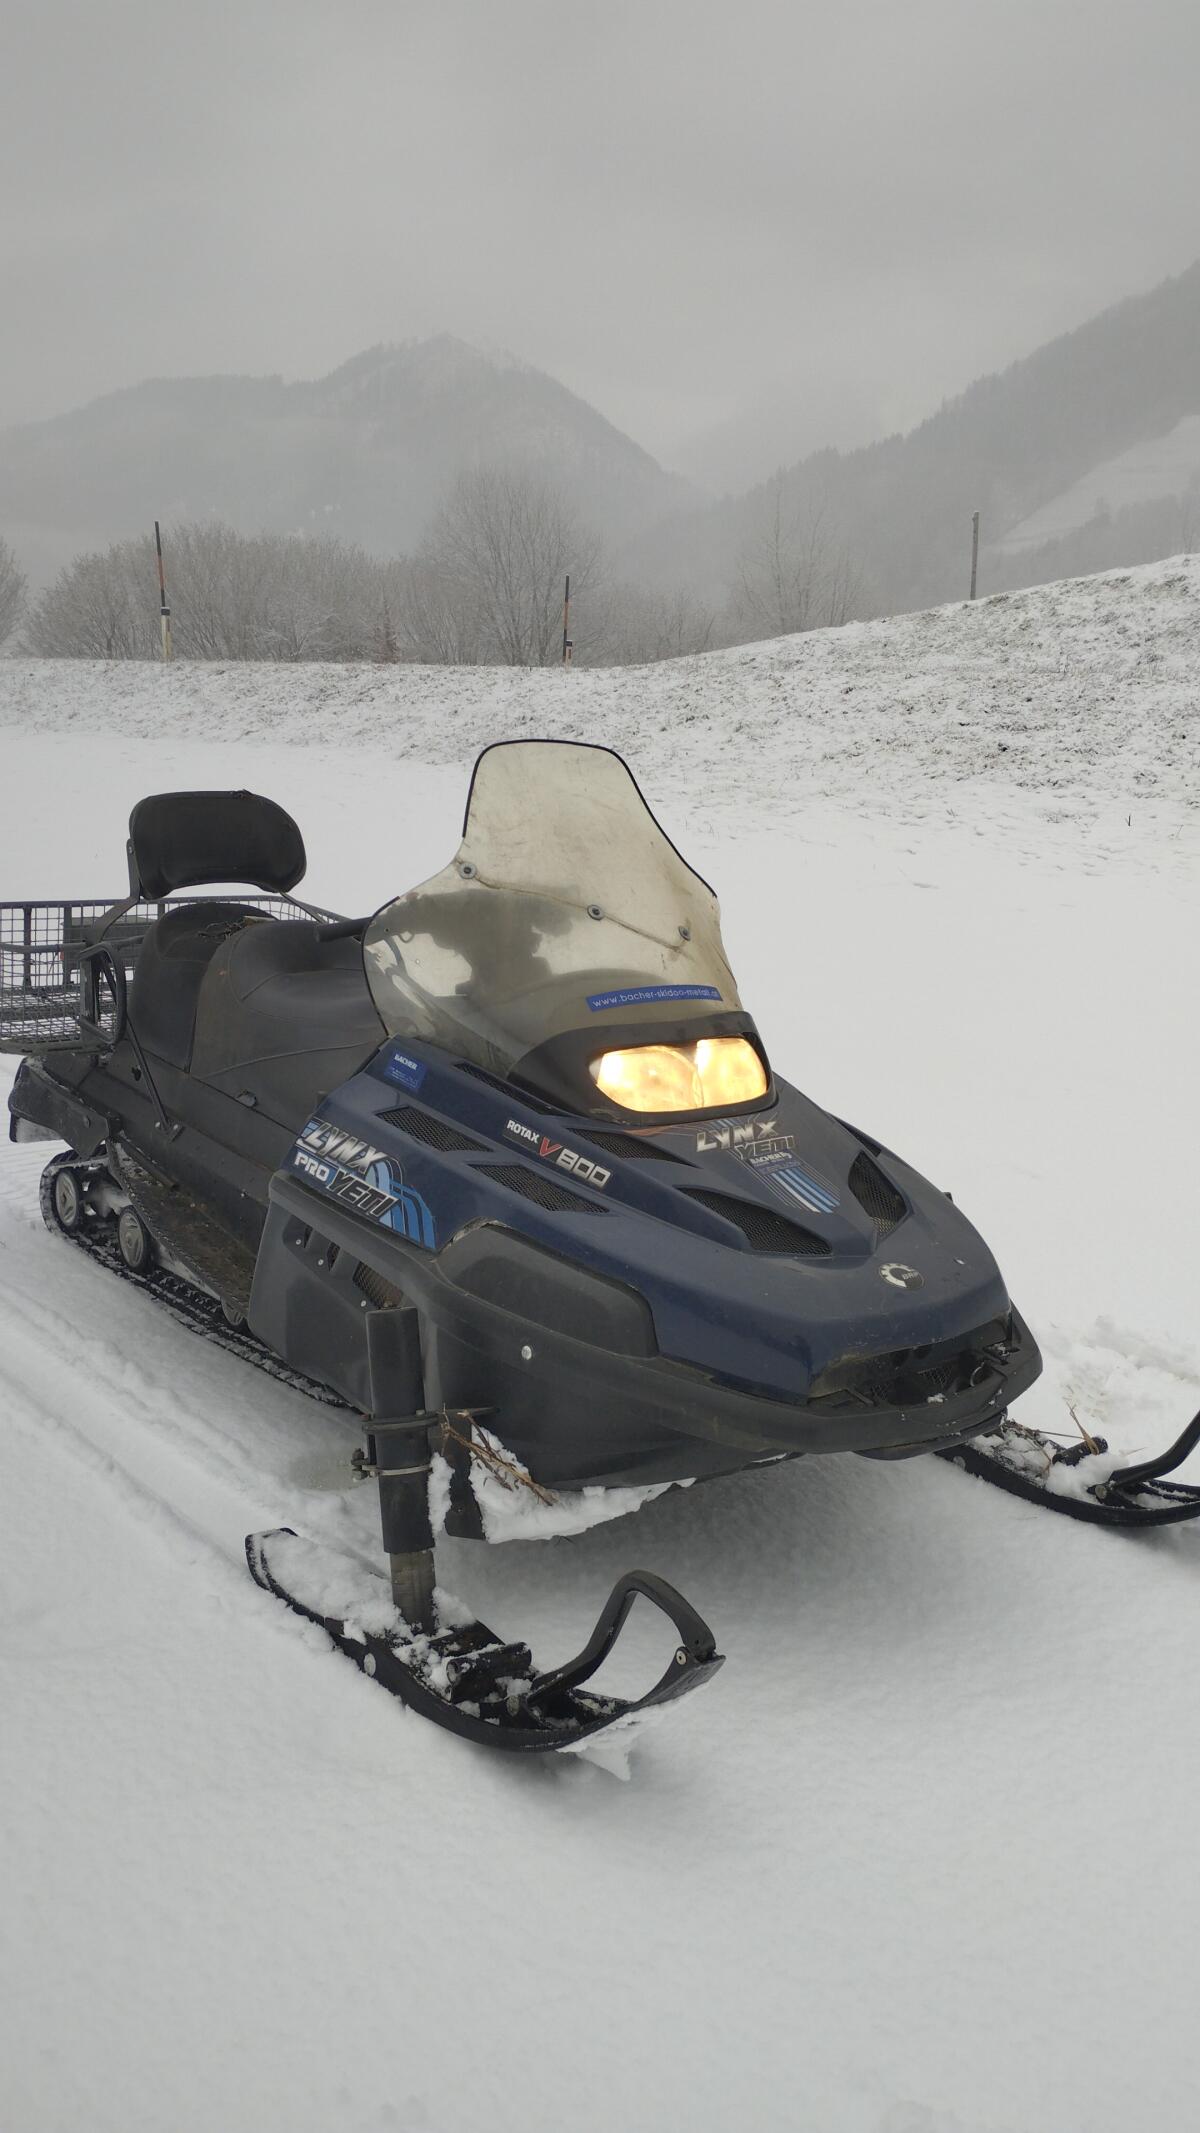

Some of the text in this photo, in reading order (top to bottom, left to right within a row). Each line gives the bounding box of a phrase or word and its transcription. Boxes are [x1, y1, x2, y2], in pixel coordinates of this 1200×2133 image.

[394, 1053, 418, 1071] BACHER
[506, 1119, 540, 1144] ROTAX
[696, 1120, 778, 1152] LYNX
[299, 1121, 388, 1174] LYNX
[734, 1135, 796, 1160] YETI
[294, 1151, 400, 1218] PRO YETI
